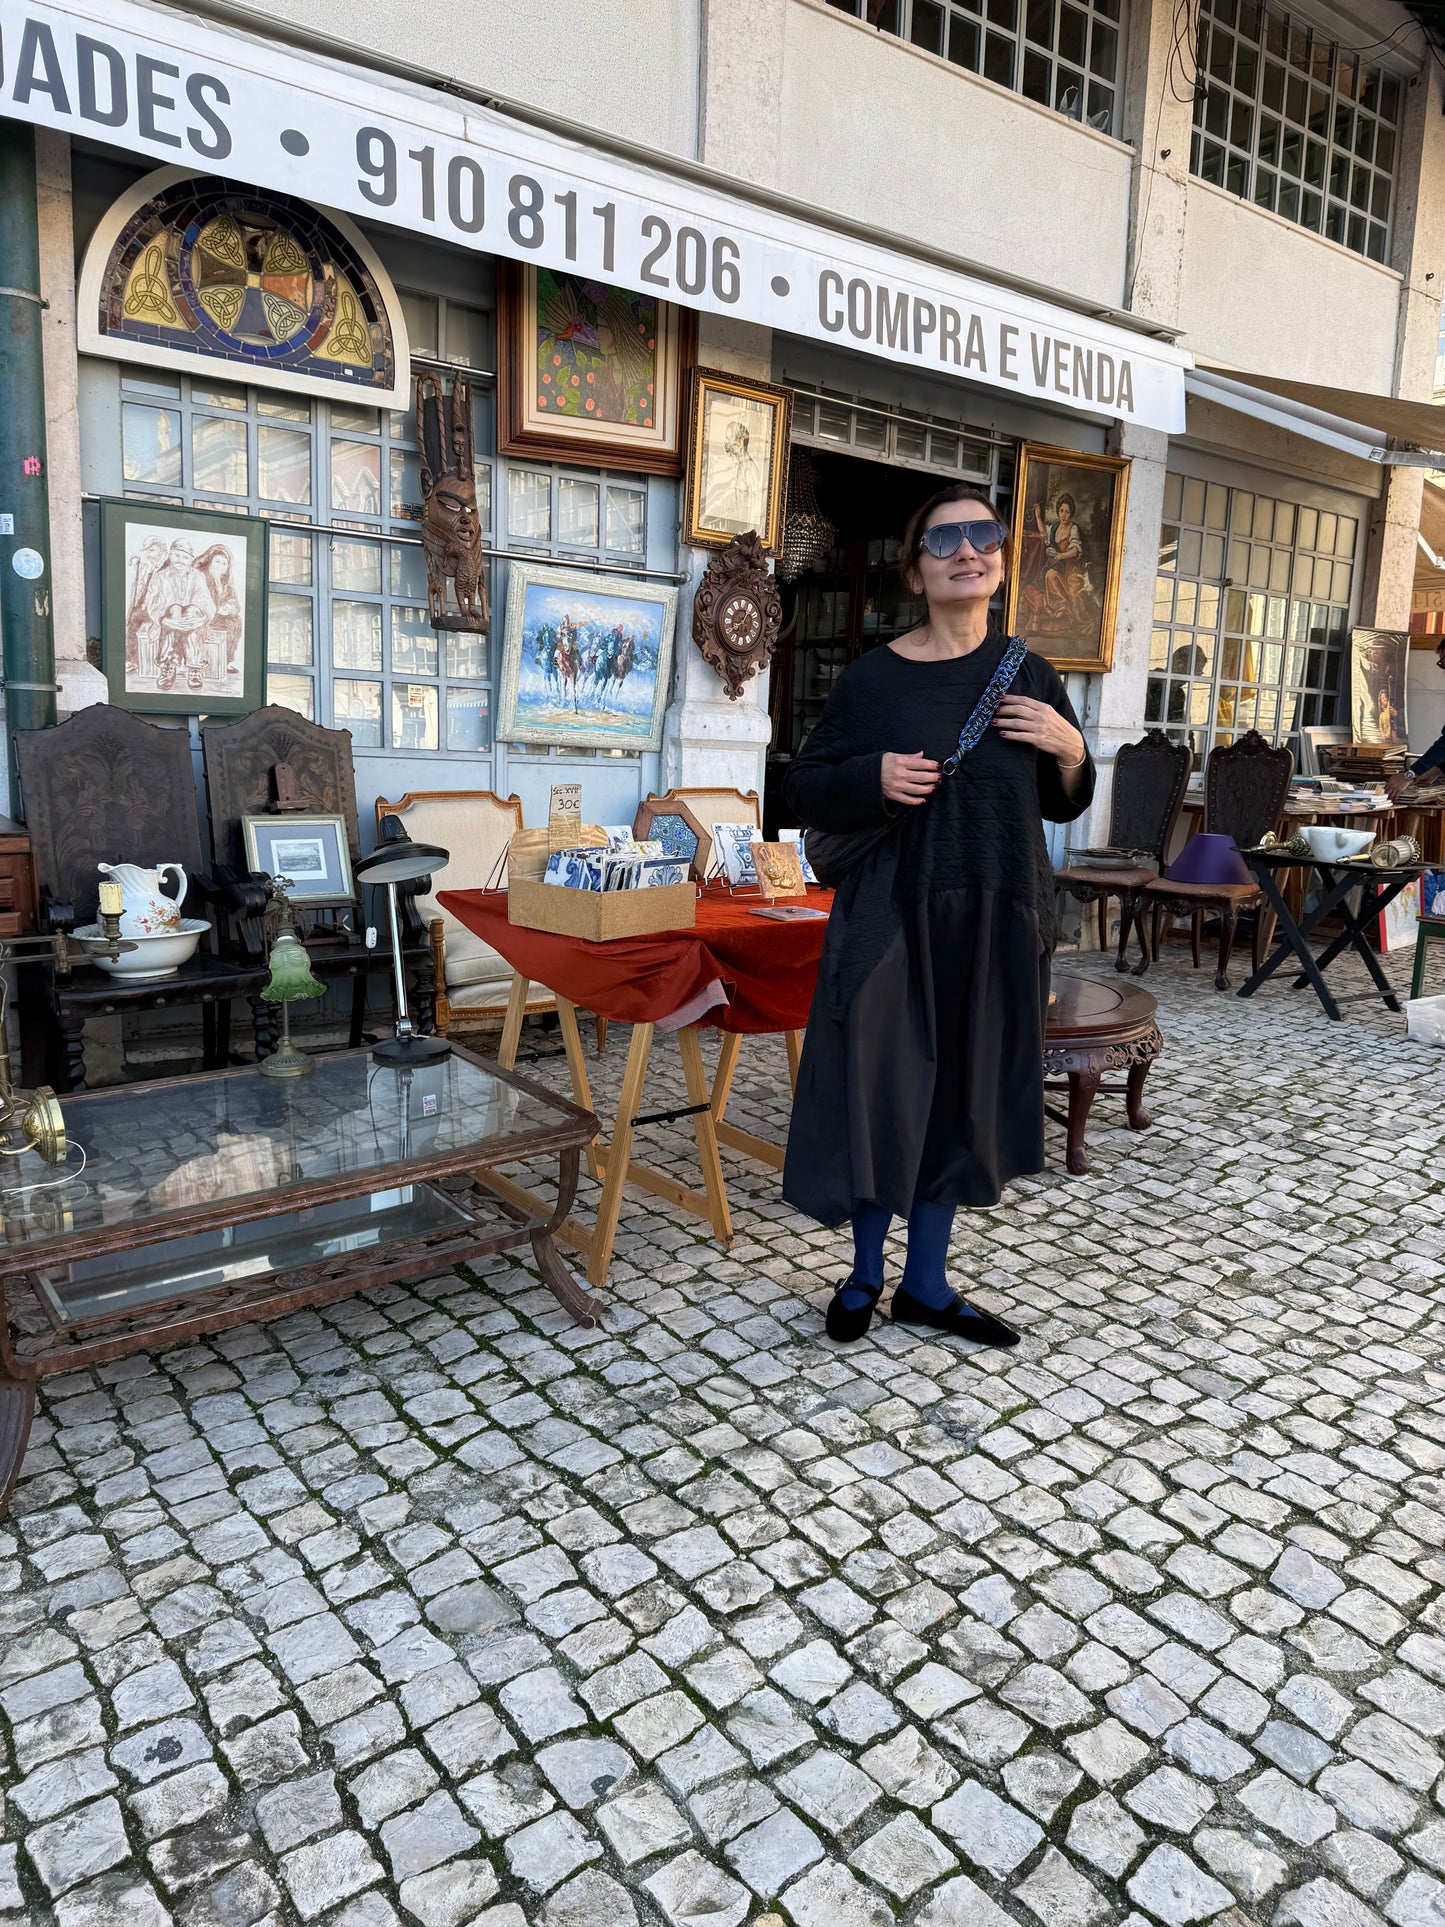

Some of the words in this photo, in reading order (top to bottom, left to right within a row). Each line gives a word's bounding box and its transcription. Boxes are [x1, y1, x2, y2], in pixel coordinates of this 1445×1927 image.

[0, 18, 232, 160] ADES
[355, 126, 486, 234] 910
[507, 174, 616, 273] 811
[640, 215, 741, 304] 206
[818, 269, 987, 373] COMPRA
[999, 323, 1019, 381] E
[1030, 332, 1136, 413] VENDA
[558, 798, 580, 810] 30€
